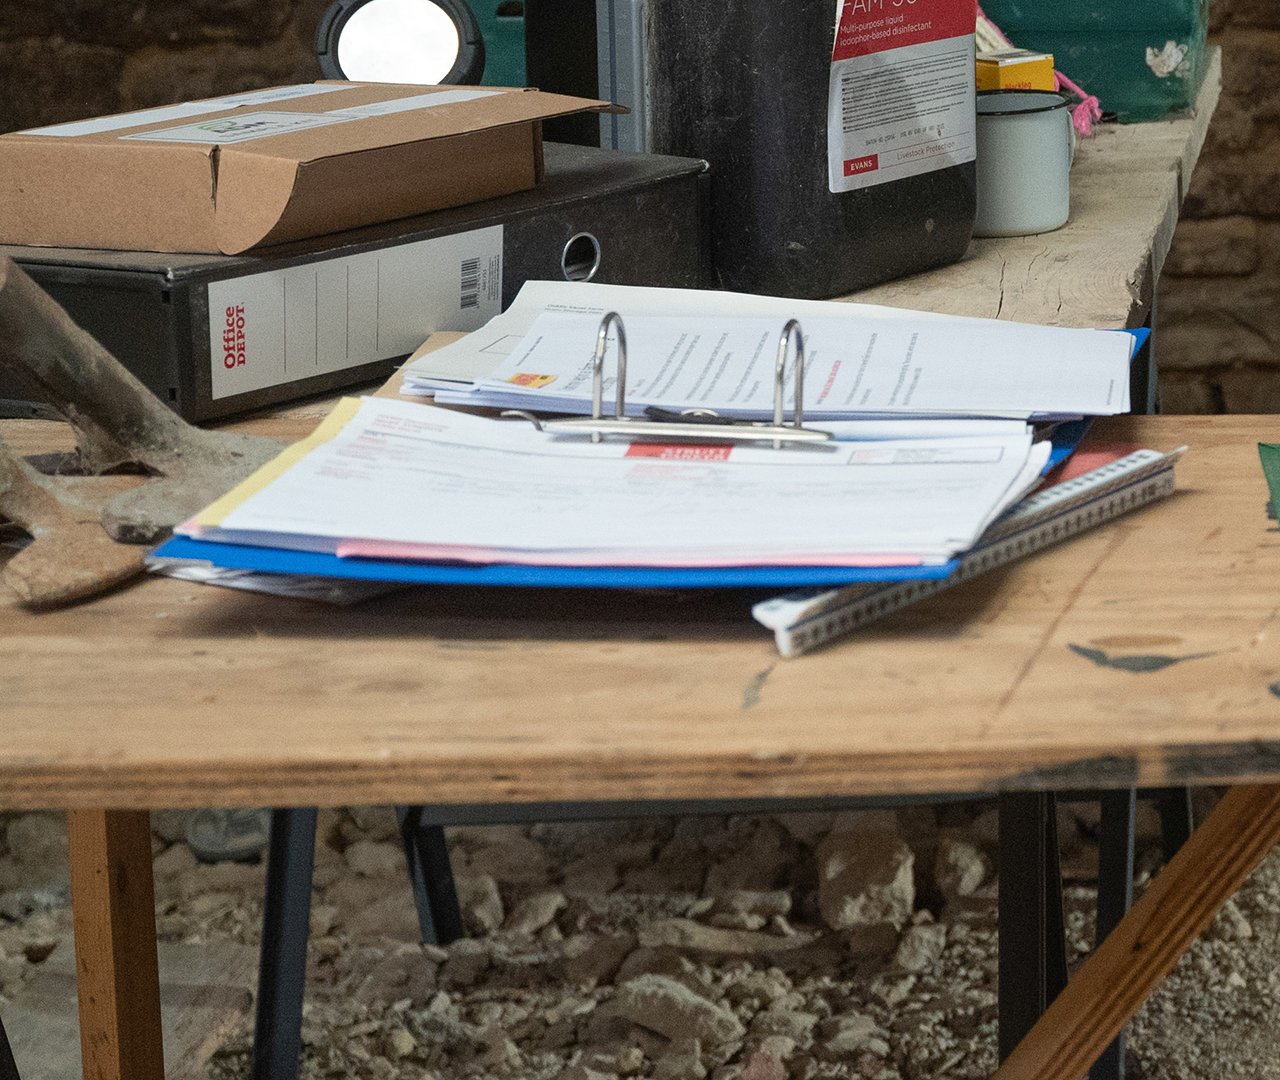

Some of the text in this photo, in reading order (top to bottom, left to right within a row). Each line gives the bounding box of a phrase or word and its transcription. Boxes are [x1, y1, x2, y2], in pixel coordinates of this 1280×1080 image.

[840, 14, 904, 35] Multi-purpose liquid
[892, 21, 932, 35] disinfectant
[897, 141, 956, 161] Livestock Protection
[850, 159, 873, 171] EVANS
[223, 306, 236, 369] Office
[236, 305, 246, 367] DEPOT
